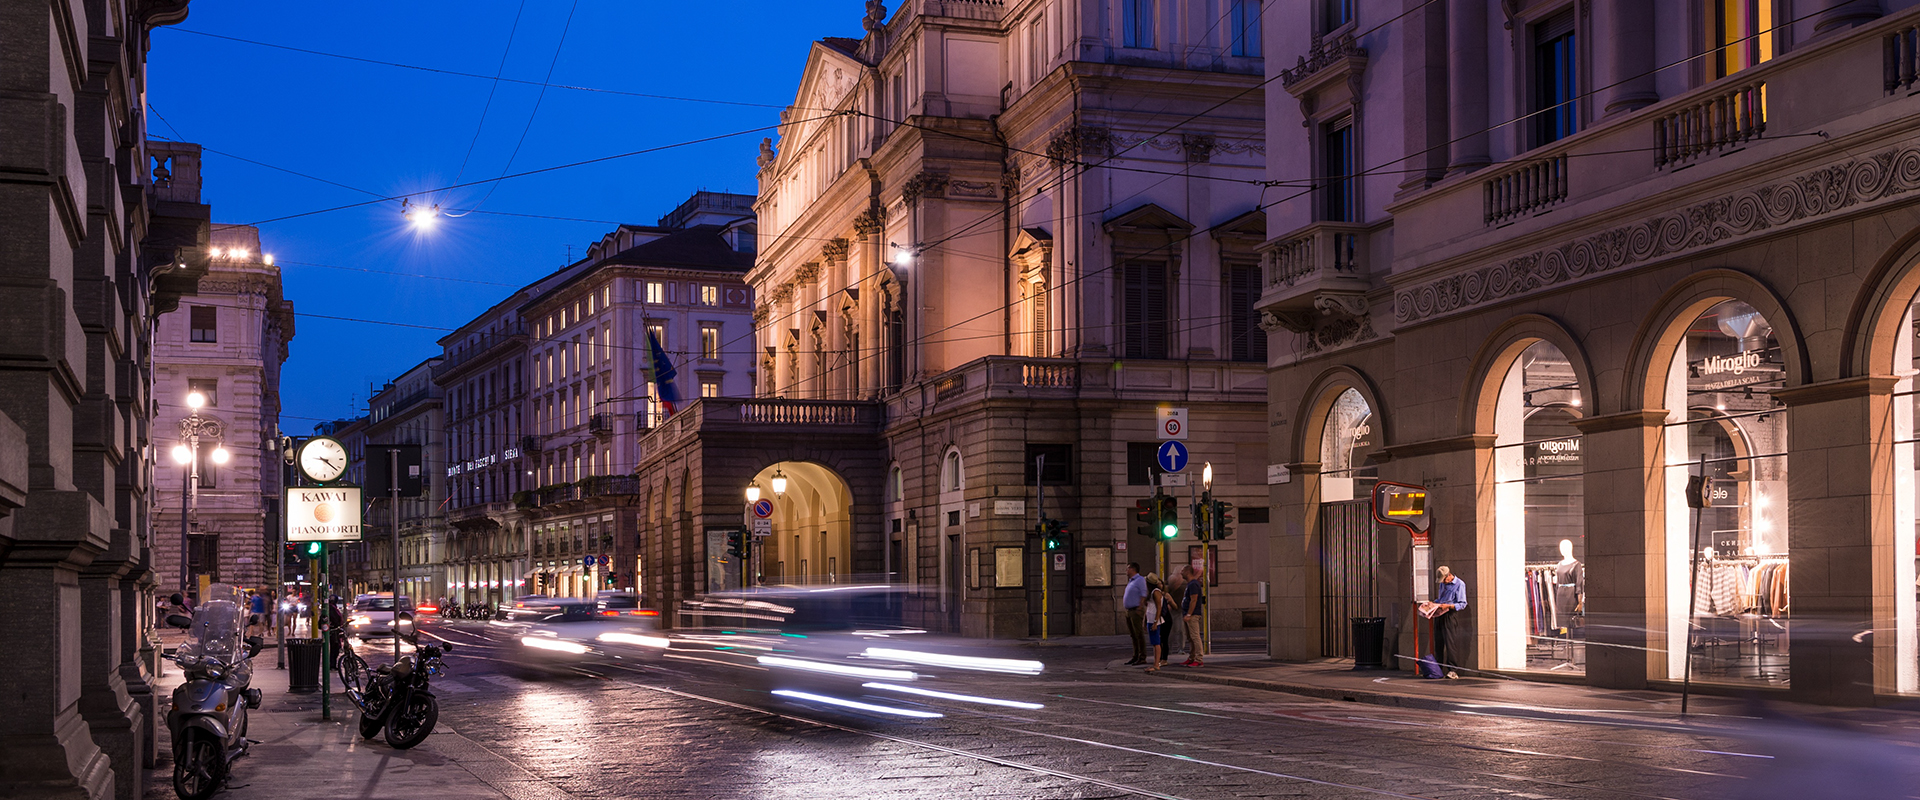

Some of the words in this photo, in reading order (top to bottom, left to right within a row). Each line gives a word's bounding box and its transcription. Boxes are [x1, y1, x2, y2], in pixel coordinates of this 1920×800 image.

[1704, 350, 1760, 375] Miroglio
[1724, 379, 1742, 388] DELLA
[1742, 376, 1760, 385] SCALA
[302, 492, 347, 502] KAWAI
[291, 525, 359, 534] PIANOFORTI
